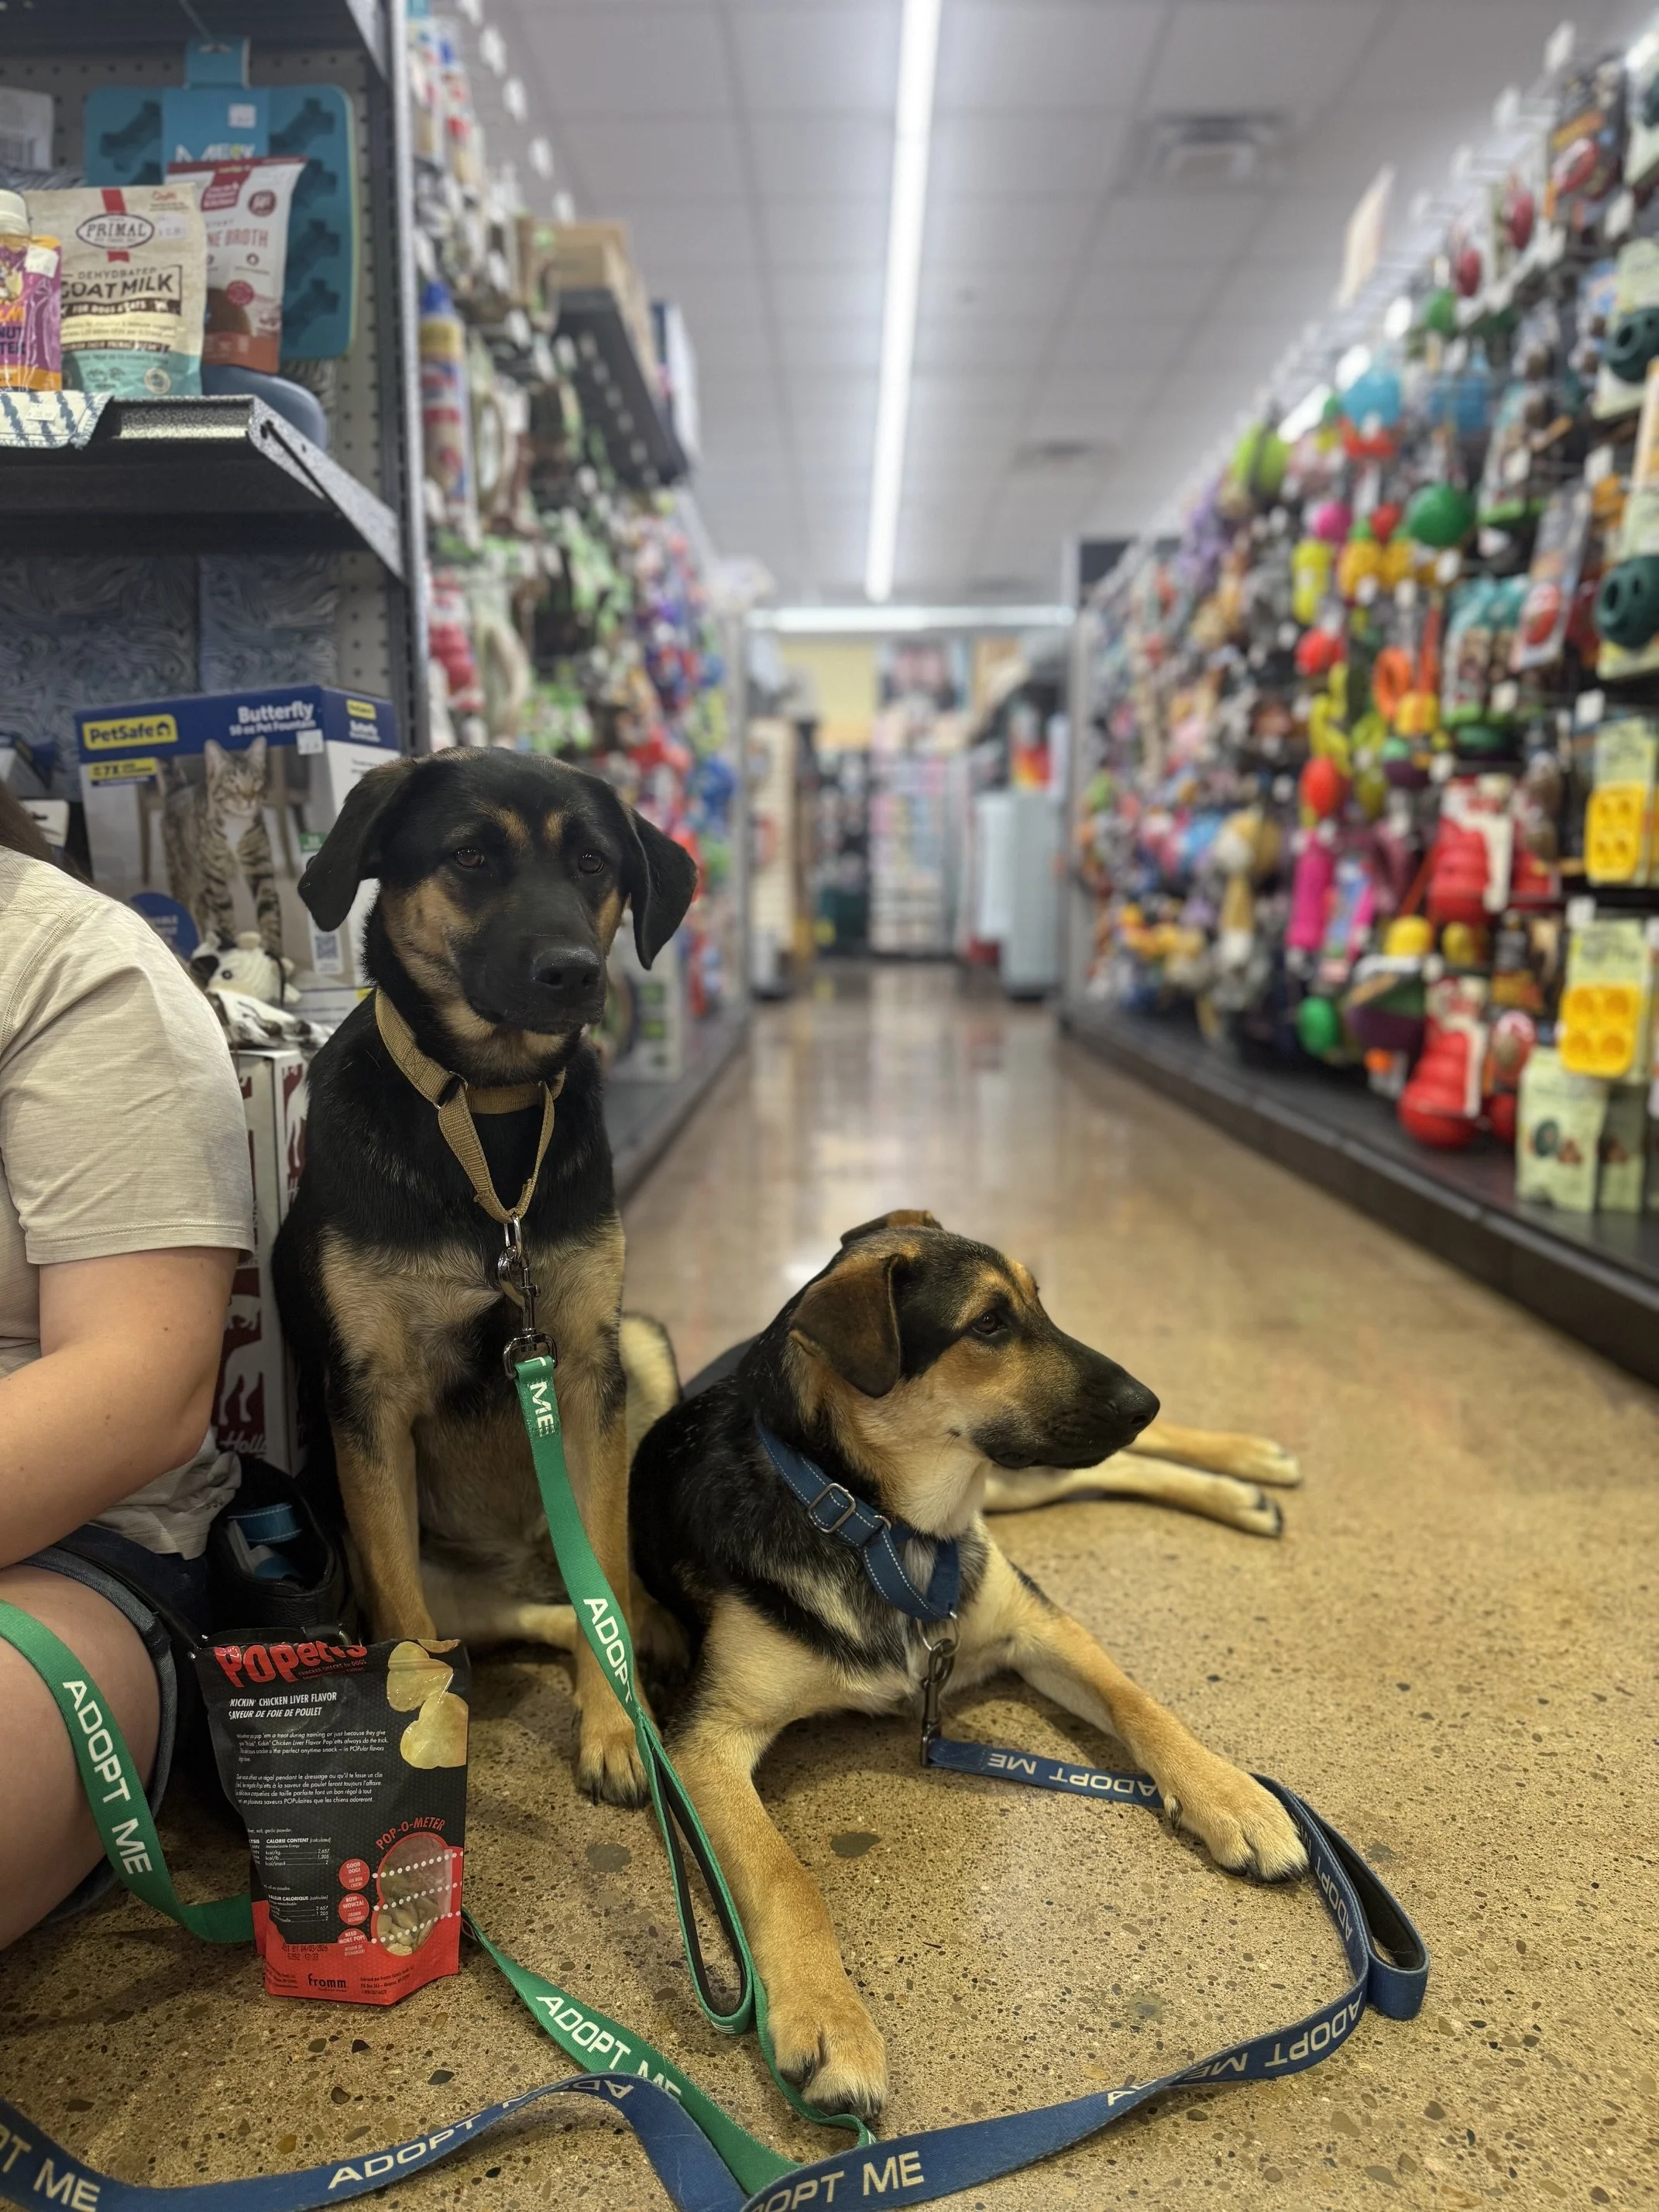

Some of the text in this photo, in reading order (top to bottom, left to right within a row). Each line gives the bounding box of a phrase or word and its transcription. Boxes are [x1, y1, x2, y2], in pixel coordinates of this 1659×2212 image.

[86, 222, 148, 239] PRIMAL
[121, 273, 173, 297] MILK
[238, 700, 314, 724] Butterfly
[90, 722, 154, 744] PetSafe
[530, 1381, 555, 1437] ME
[228, 1706, 322, 1720] SAVEUR DE FOIE DE POULET
[259, 1695, 288, 1706] CHICKEN
[290, 1694, 309, 1705] LIVER
[311, 1692, 337, 1703] FLAVOR
[63, 1680, 153, 1875] ADOPT ME
[988, 1753, 1159, 1797] ADOPT ME
[375, 1816, 446, 1850] POP-O-METER
[338, 1936, 353, 1944] MORE
[307, 1973, 346, 1988] fromm
[536, 1996, 632, 2070] ADOPT
[1182, 1990, 1363, 2081] ADOPT ME
[328, 2114, 482, 2190] ADOPT
[33, 2158, 101, 2212] ME
[863, 2150, 925, 2197] ME
